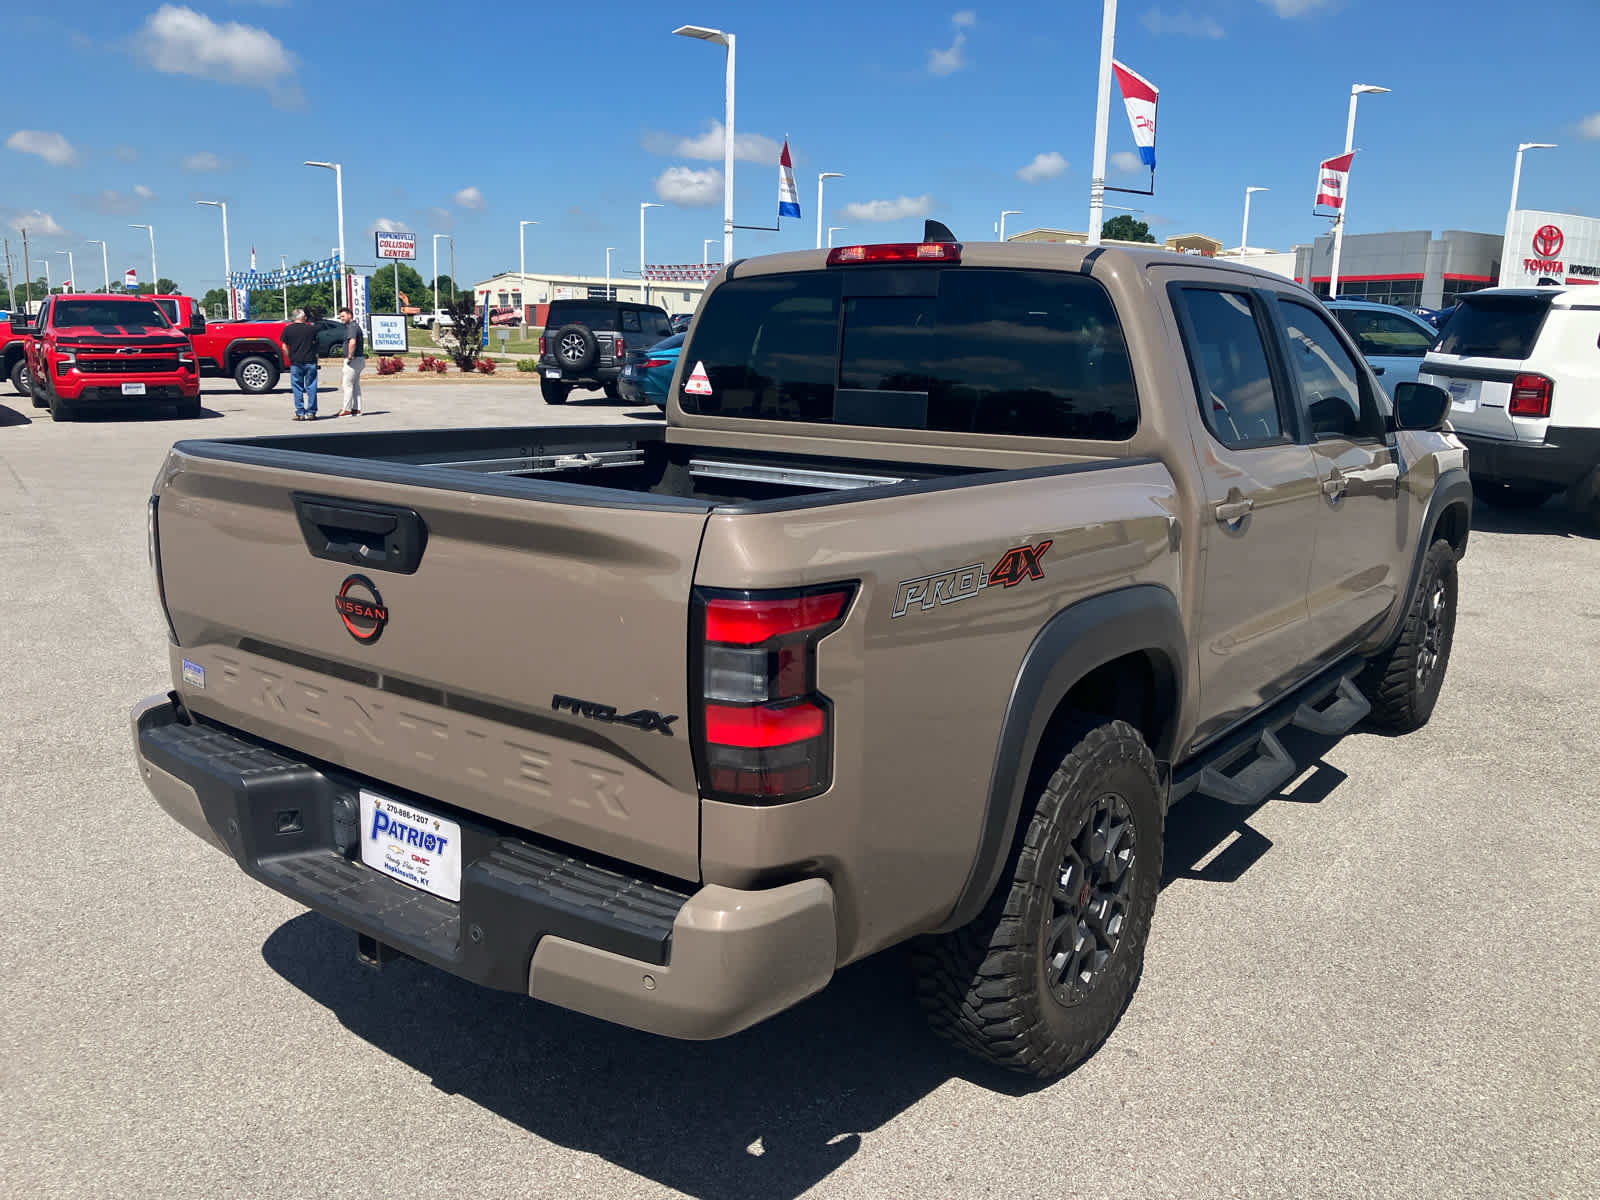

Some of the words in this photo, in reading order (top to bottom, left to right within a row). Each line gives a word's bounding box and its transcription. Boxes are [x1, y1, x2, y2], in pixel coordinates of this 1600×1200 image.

[379, 240, 414, 249] COLLISION
[384, 249, 410, 257] CENTER
[1523, 258, 1564, 273] TOYOTA
[336, 599, 386, 620] NISSAN
[552, 694, 679, 736] PRO-4X
[212, 654, 632, 820] FRONTIER
[386, 803, 429, 825] 270-886-1207
[371, 809, 448, 855] PATRIOT
[411, 854, 431, 866] GMC
[384, 861, 420, 885] Hopkinsville,
[420, 877, 430, 887] KY
